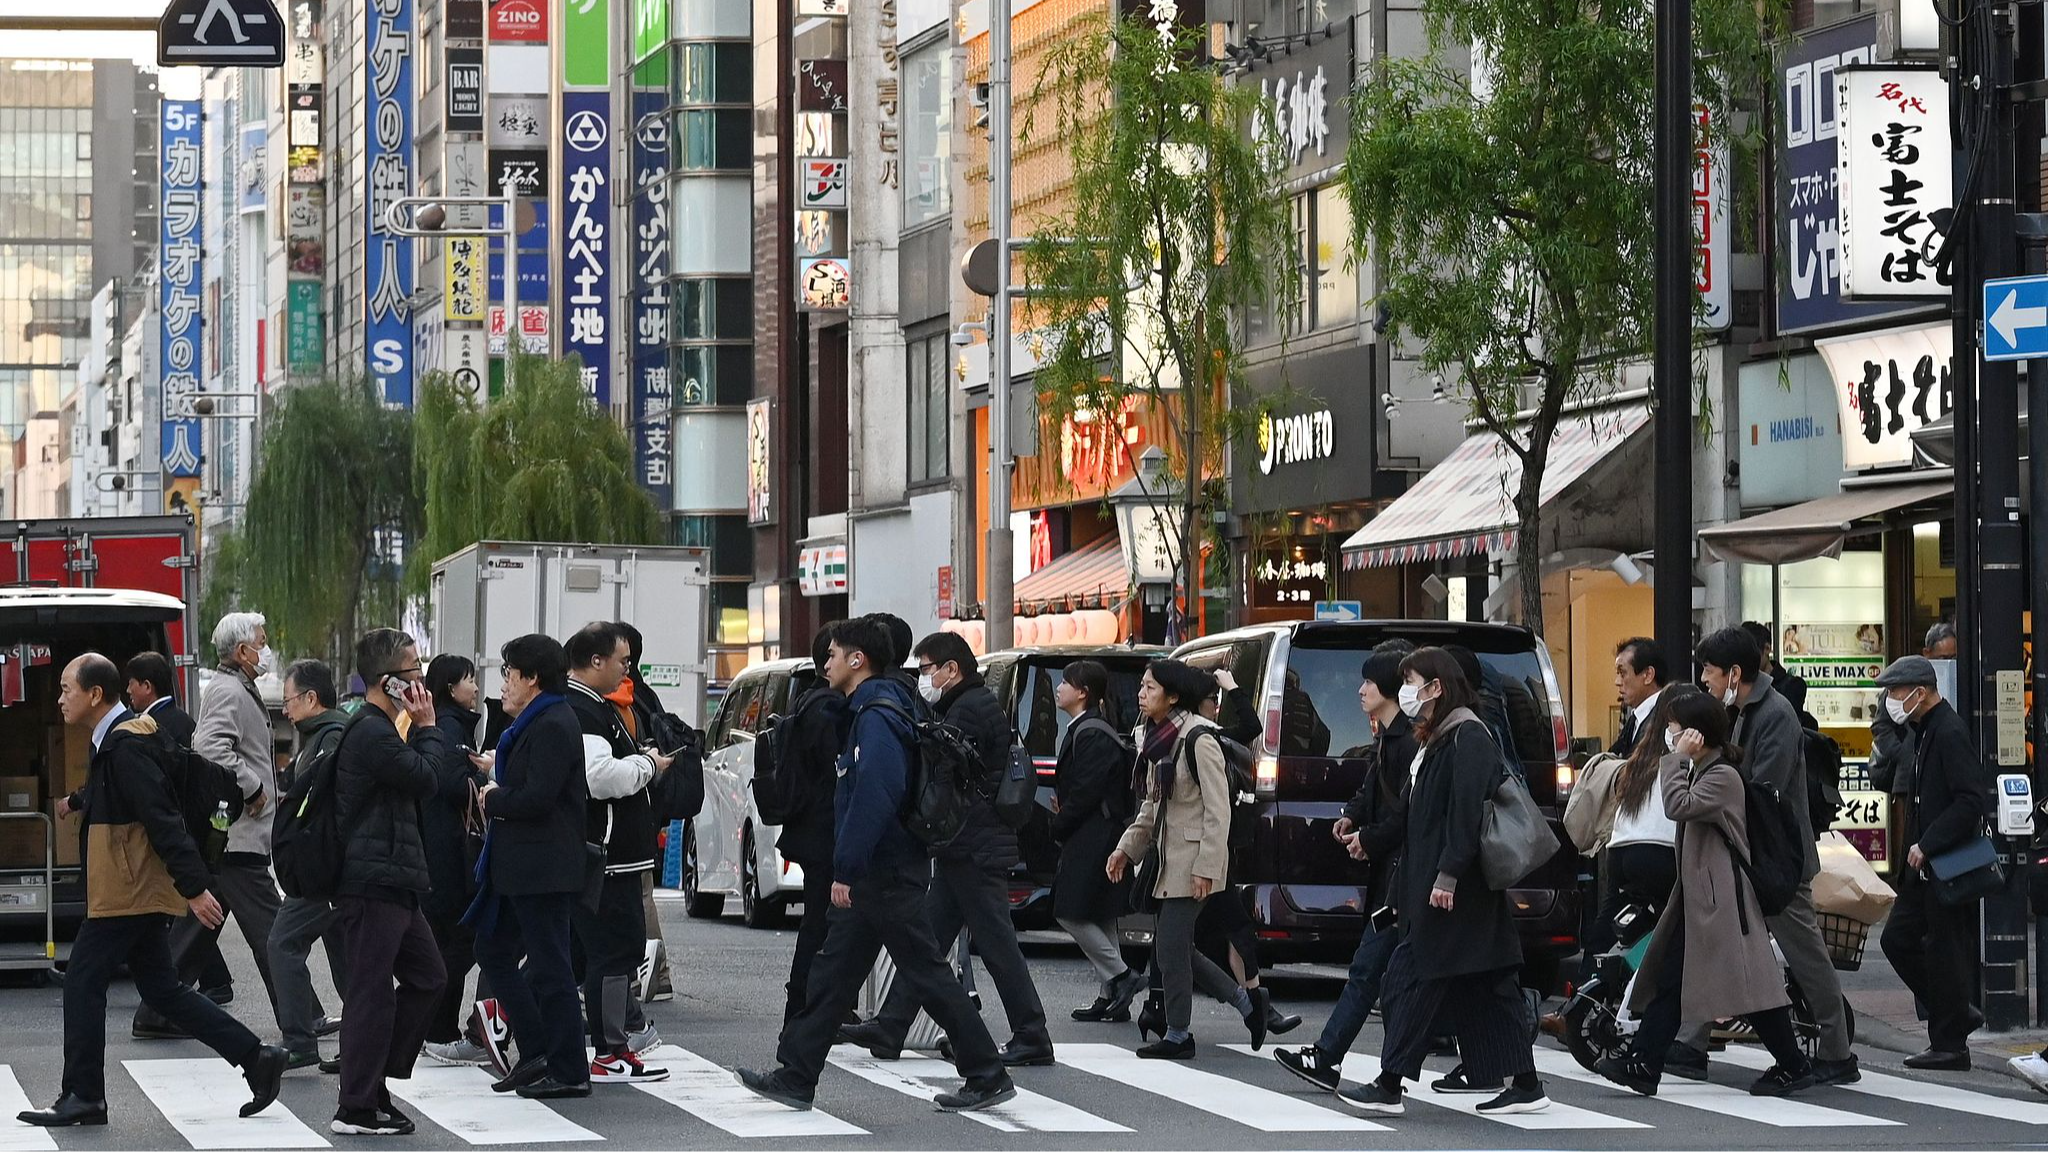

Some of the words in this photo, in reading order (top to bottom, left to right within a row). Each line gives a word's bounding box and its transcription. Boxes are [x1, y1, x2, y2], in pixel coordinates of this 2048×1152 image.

[497, 11, 541, 23] ZINO
[453, 70, 479, 89] BAR
[453, 102, 478, 112] LIGHT
[455, 93, 477, 101] MOON
[1876, 82, 1927, 115] 名代
[165, 105, 198, 132] 5F
[567, 165, 606, 345] かんべ土地
[162, 137, 201, 475] カラオケの鉄人
[1275, 409, 1333, 465] PRONTO
[1770, 416, 1814, 443] HANABISI
[1800, 665, 1831, 679] LiVE
[1833, 665, 1865, 679] MAX
